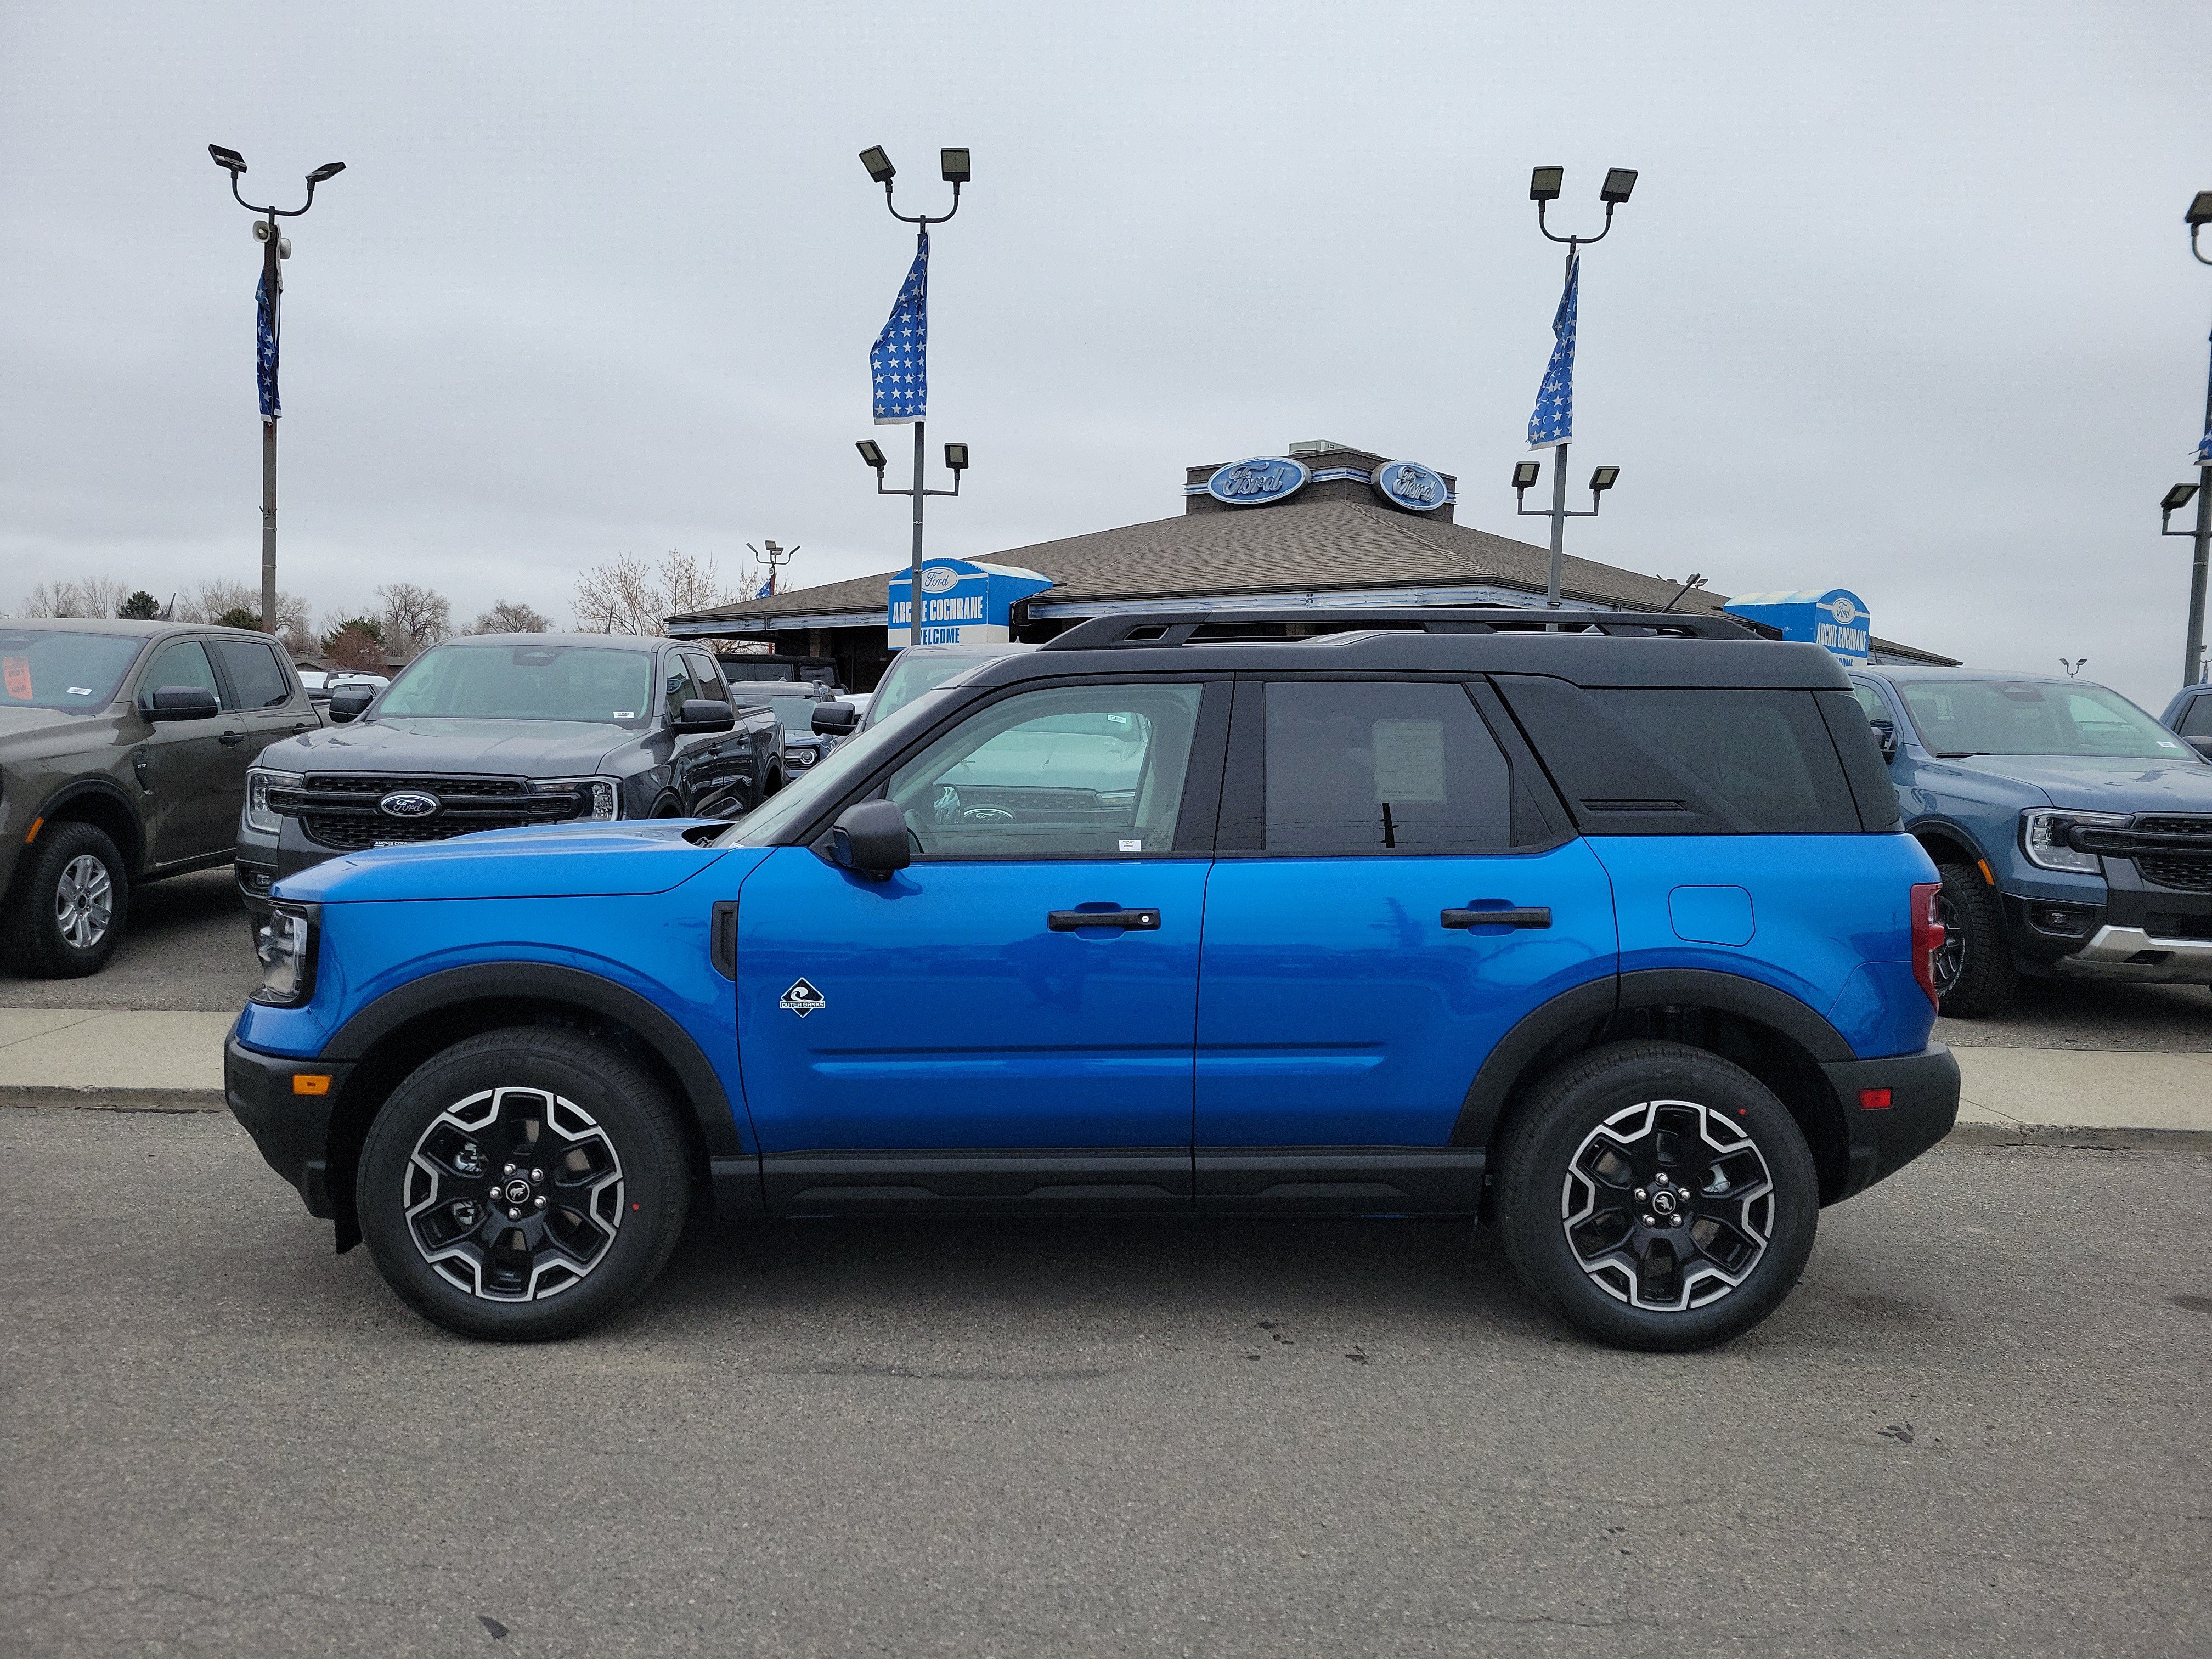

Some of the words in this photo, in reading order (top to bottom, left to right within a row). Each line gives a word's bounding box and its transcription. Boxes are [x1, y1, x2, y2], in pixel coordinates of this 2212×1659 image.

[1223, 462, 1284, 496] Ford
[1392, 466, 1437, 503] Ford
[925, 571, 949, 587] Ford
[893, 601, 927, 623] ARCE
[930, 596, 983, 621] COCHRANE
[1837, 602, 1850, 618] Ford
[1816, 622, 1837, 647] ARCHIE
[1838, 626, 1866, 652] COCHRANE
[393, 799, 422, 812] Ford
